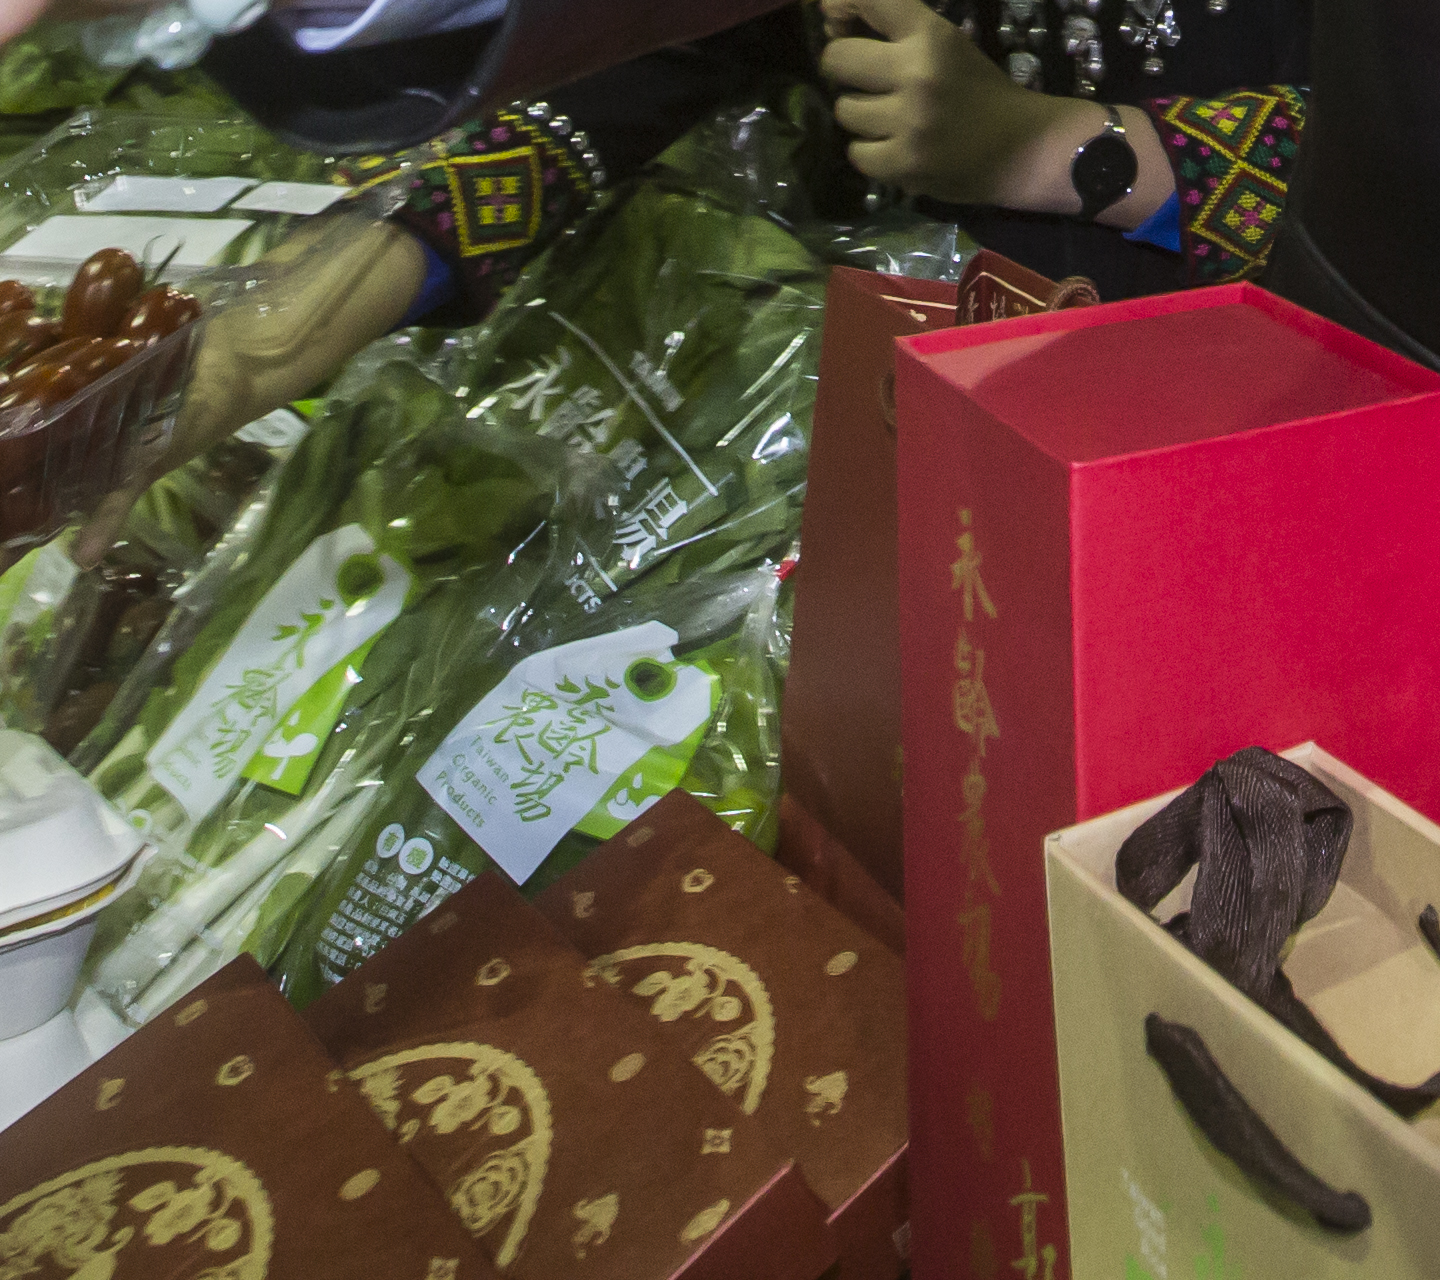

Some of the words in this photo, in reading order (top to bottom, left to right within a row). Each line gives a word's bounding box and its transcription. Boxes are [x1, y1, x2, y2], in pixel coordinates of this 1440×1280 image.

[451, 753, 499, 807] Organic
[468, 733, 510, 784] Taiwan
[434, 770, 486, 829] Products
